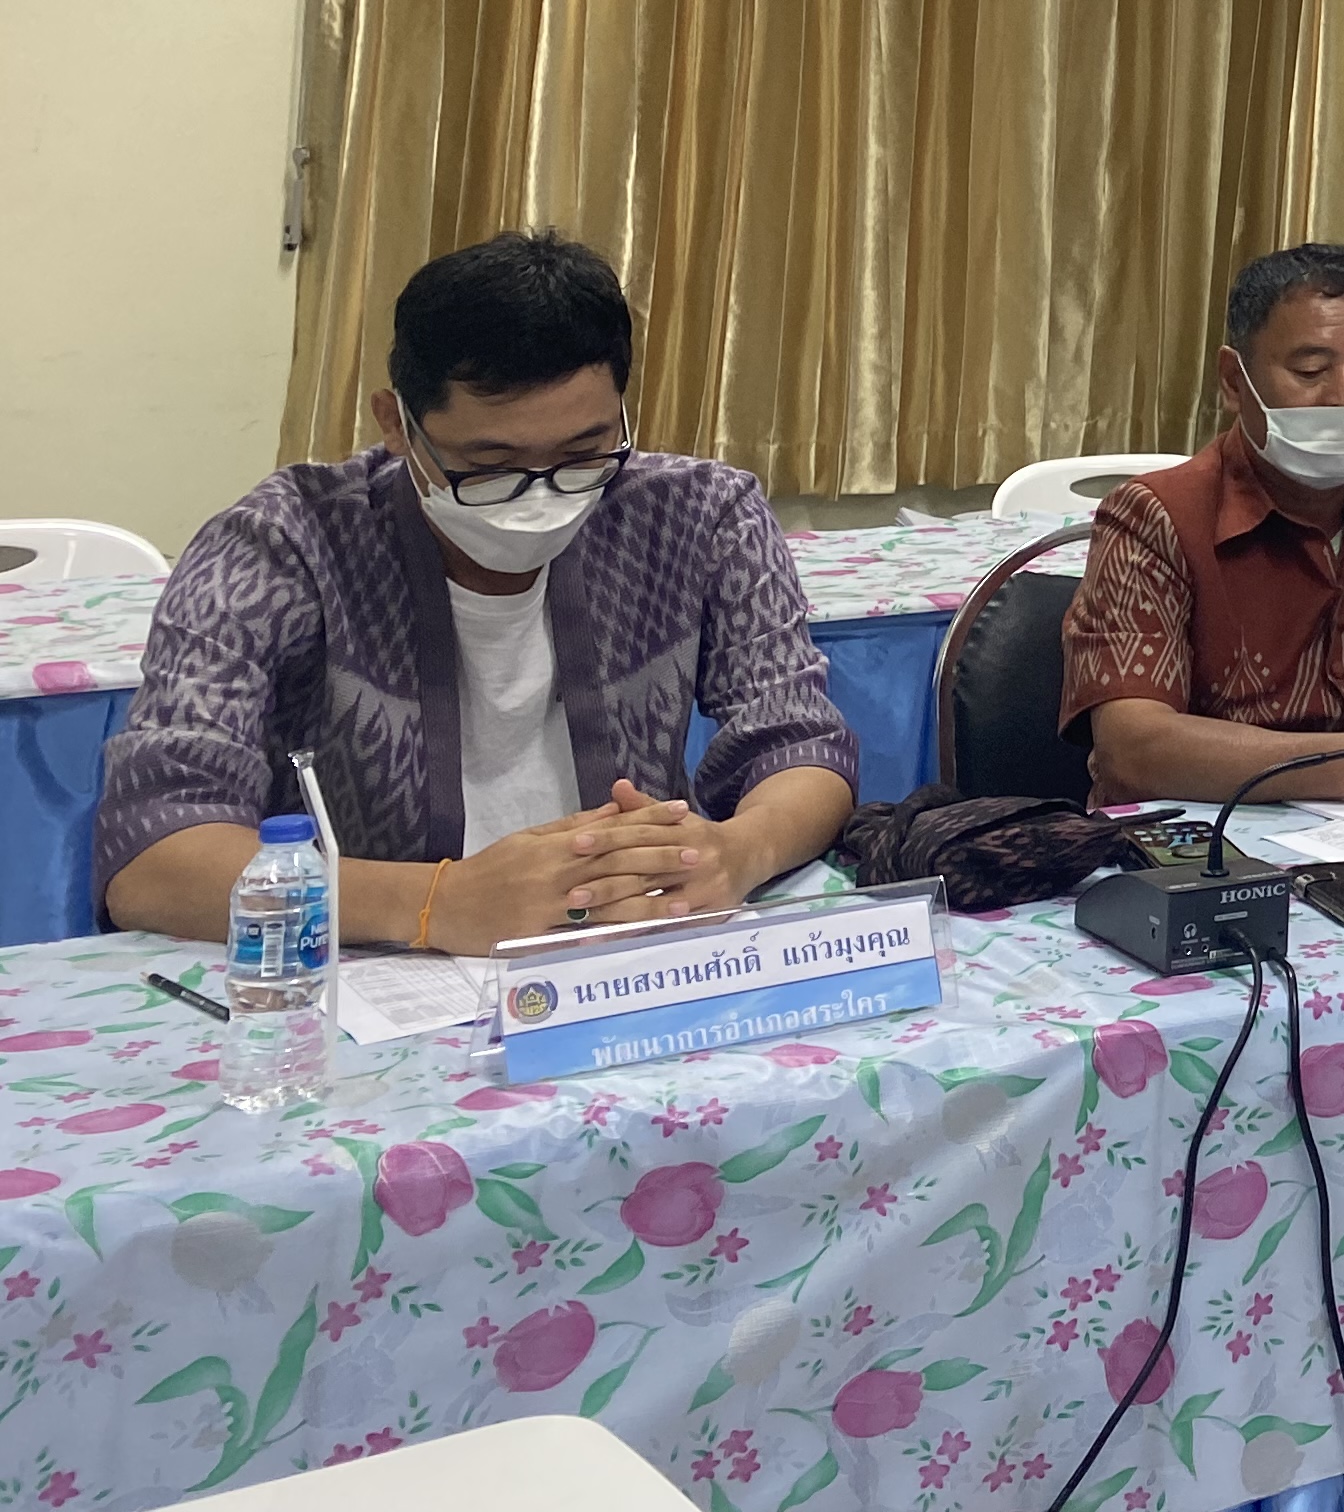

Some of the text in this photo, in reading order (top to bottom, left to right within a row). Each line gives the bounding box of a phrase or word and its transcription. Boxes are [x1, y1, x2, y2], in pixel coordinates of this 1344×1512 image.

[573, 931, 762, 1005] นายสงวนศักดิ์
